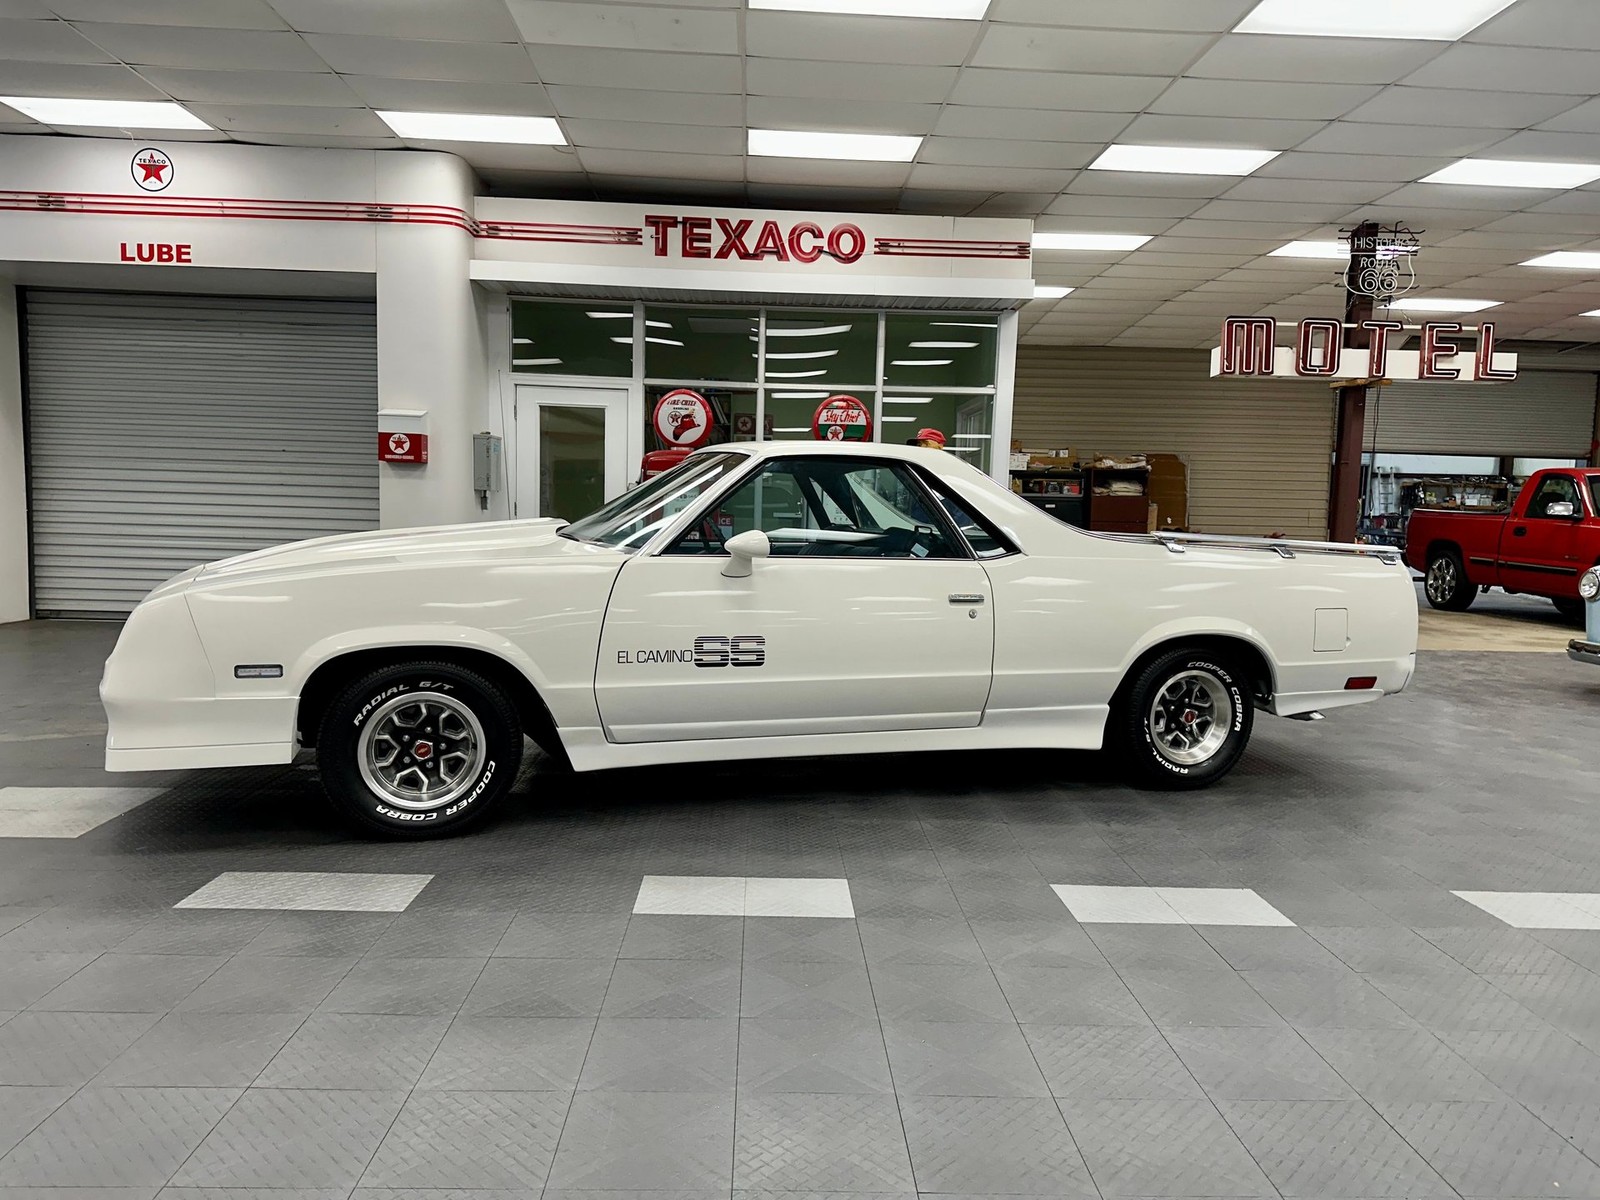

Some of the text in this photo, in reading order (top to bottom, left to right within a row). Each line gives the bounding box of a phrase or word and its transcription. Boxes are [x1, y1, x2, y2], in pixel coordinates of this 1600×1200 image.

[120, 242, 192, 263] LUBE
[645, 214, 866, 264] TEXACO
[1360, 267, 1398, 293] 66
[1220, 316, 1520, 381] MOTEL
[824, 409, 861, 424] Sky Chief
[617, 635, 766, 668] EL CAMINO SS
[353, 681, 454, 727] RADIAL G/T
[1187, 661, 1243, 732] COOPER COBRA
[1152, 747, 1189, 775] RADIAL
[375, 760, 496, 821] COOPER COBRA
